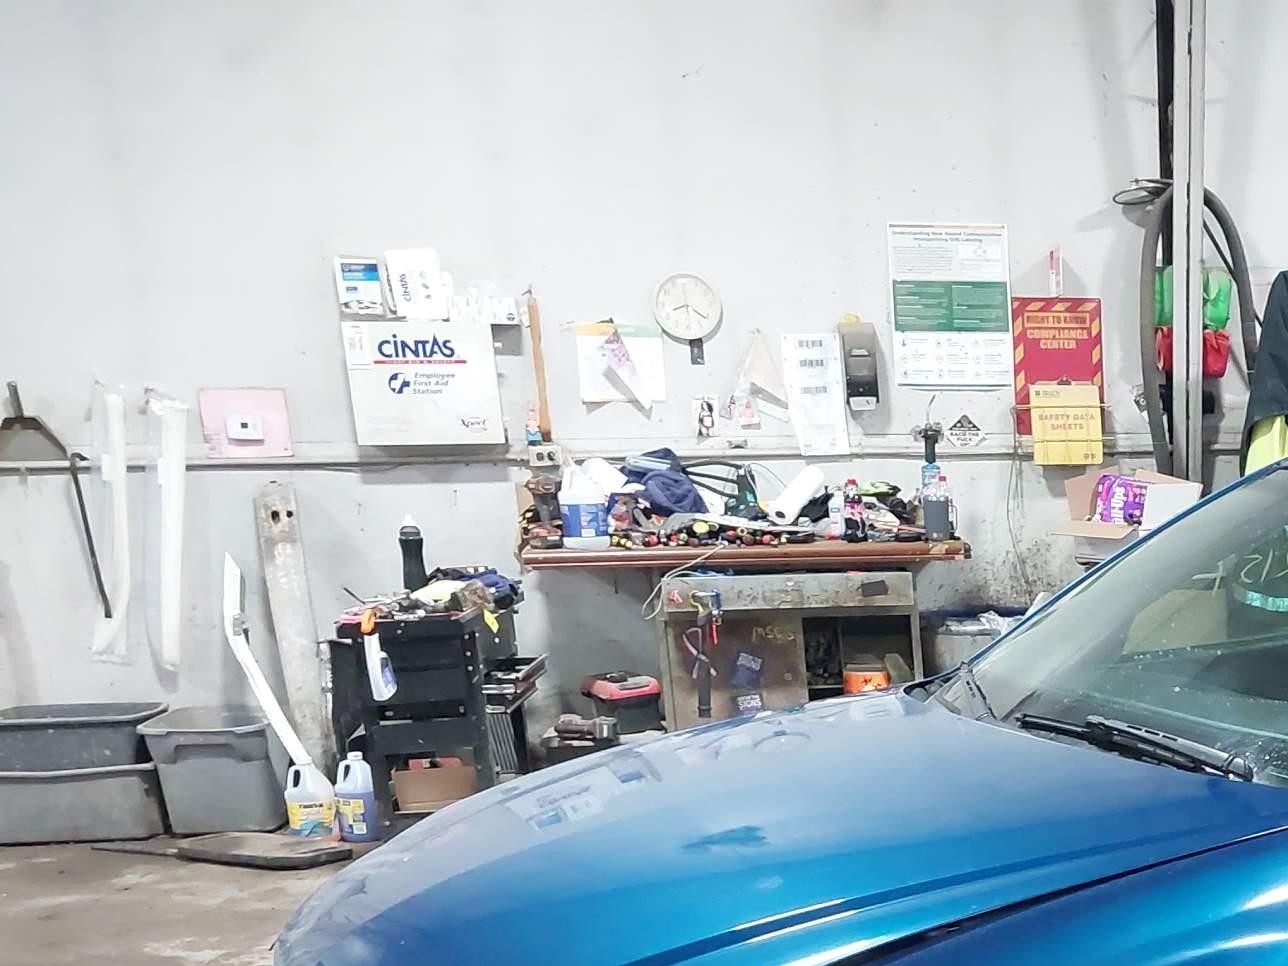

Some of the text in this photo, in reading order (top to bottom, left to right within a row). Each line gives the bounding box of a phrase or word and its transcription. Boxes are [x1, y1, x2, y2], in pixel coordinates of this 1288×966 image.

[1026, 329, 1089, 340] COMPLIANCE
[377, 333, 456, 358] CINTAS
[413, 372, 456, 380] Employee
[1038, 413, 1095, 421] SAFETY DATA
[1050, 423, 1084, 431] SHEETS
